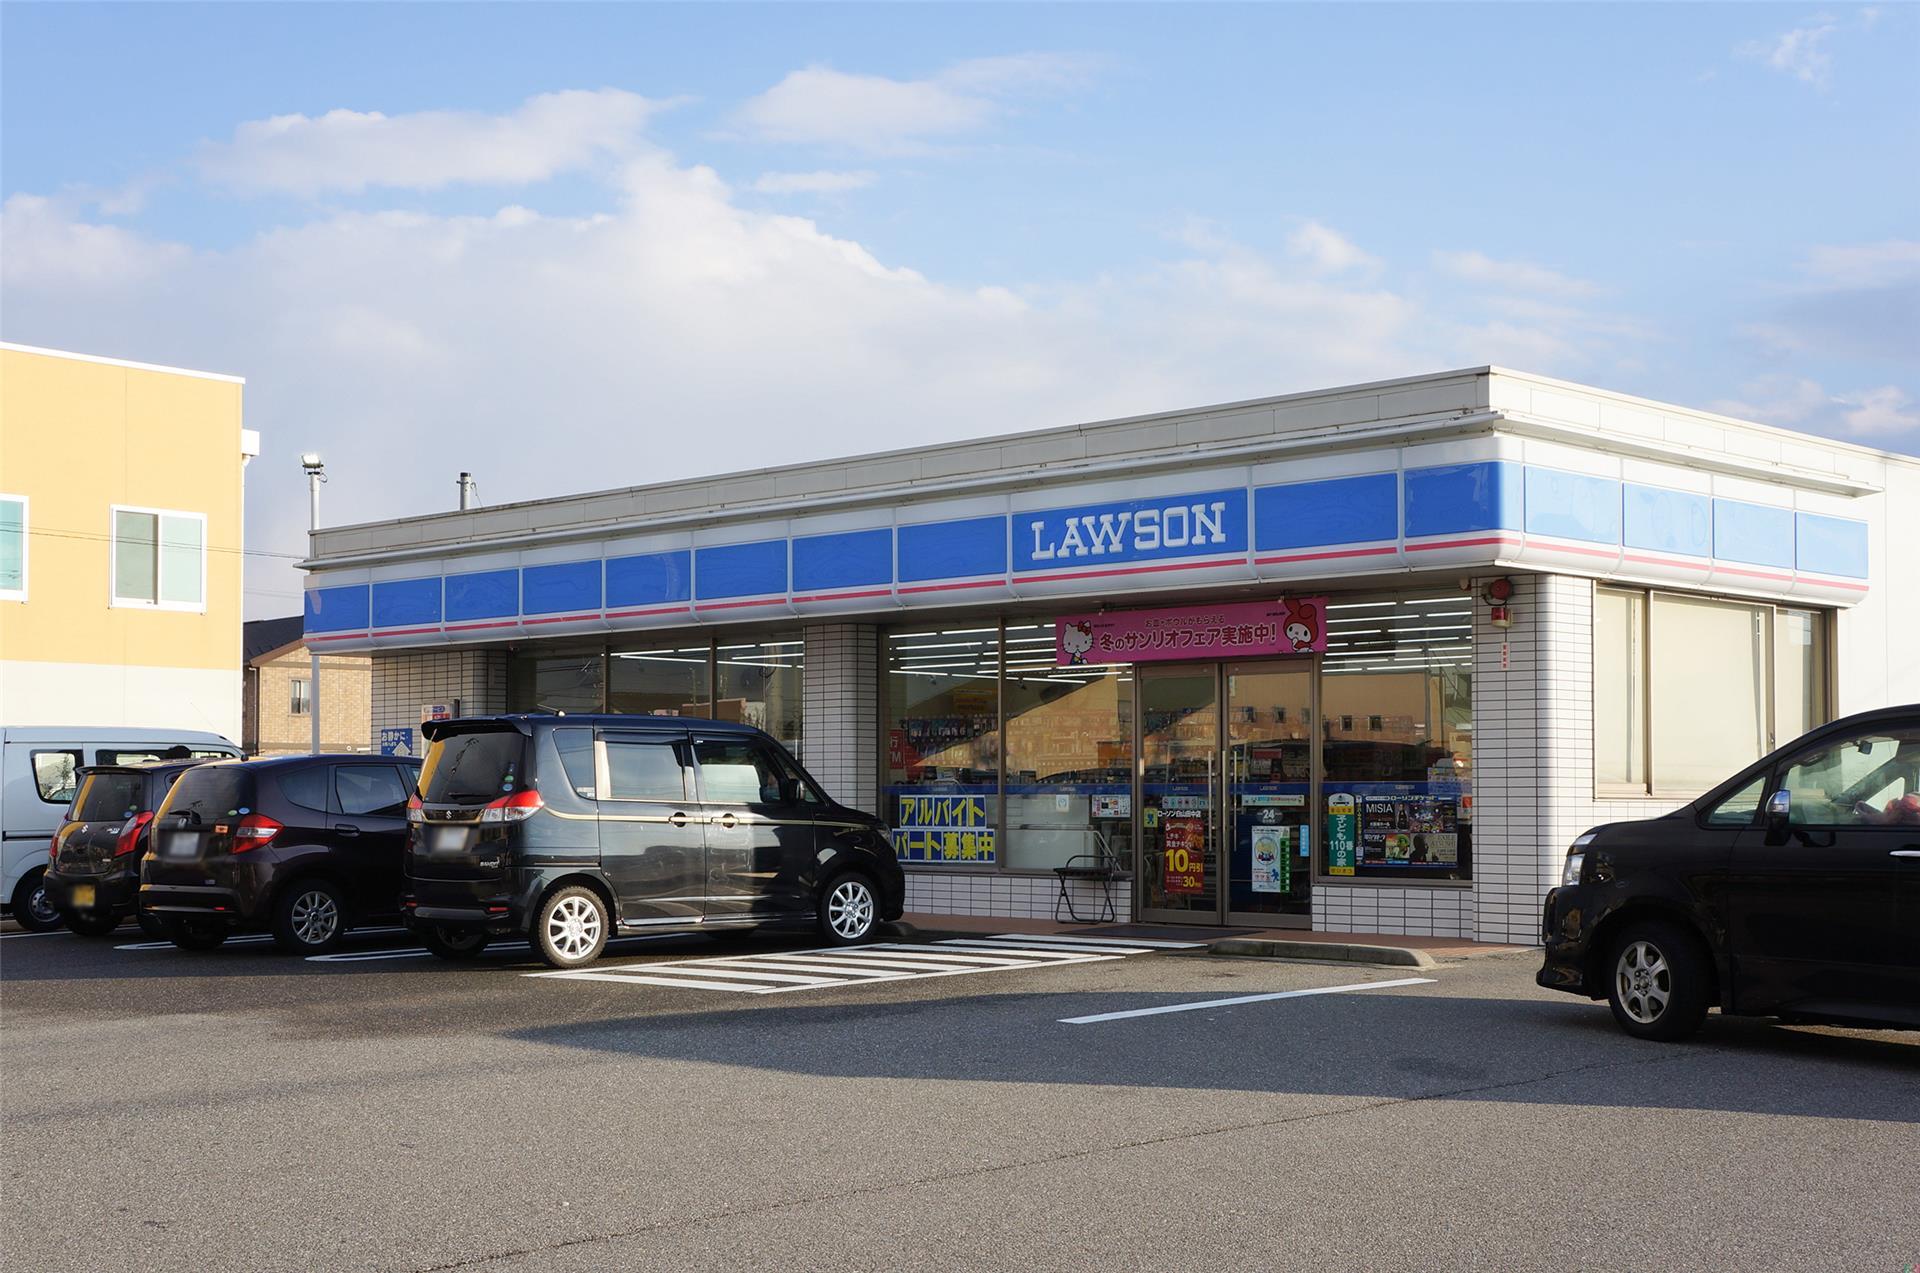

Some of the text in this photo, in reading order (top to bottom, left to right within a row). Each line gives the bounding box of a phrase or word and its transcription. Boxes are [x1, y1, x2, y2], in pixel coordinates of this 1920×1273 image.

[1031, 501, 1227, 561] LAWSON
[901, 798, 985, 827] アルバイト
[1262, 808, 1275, 819] 24
[1365, 803, 1394, 814] MISIA
[895, 831, 994, 861] パート募集中
